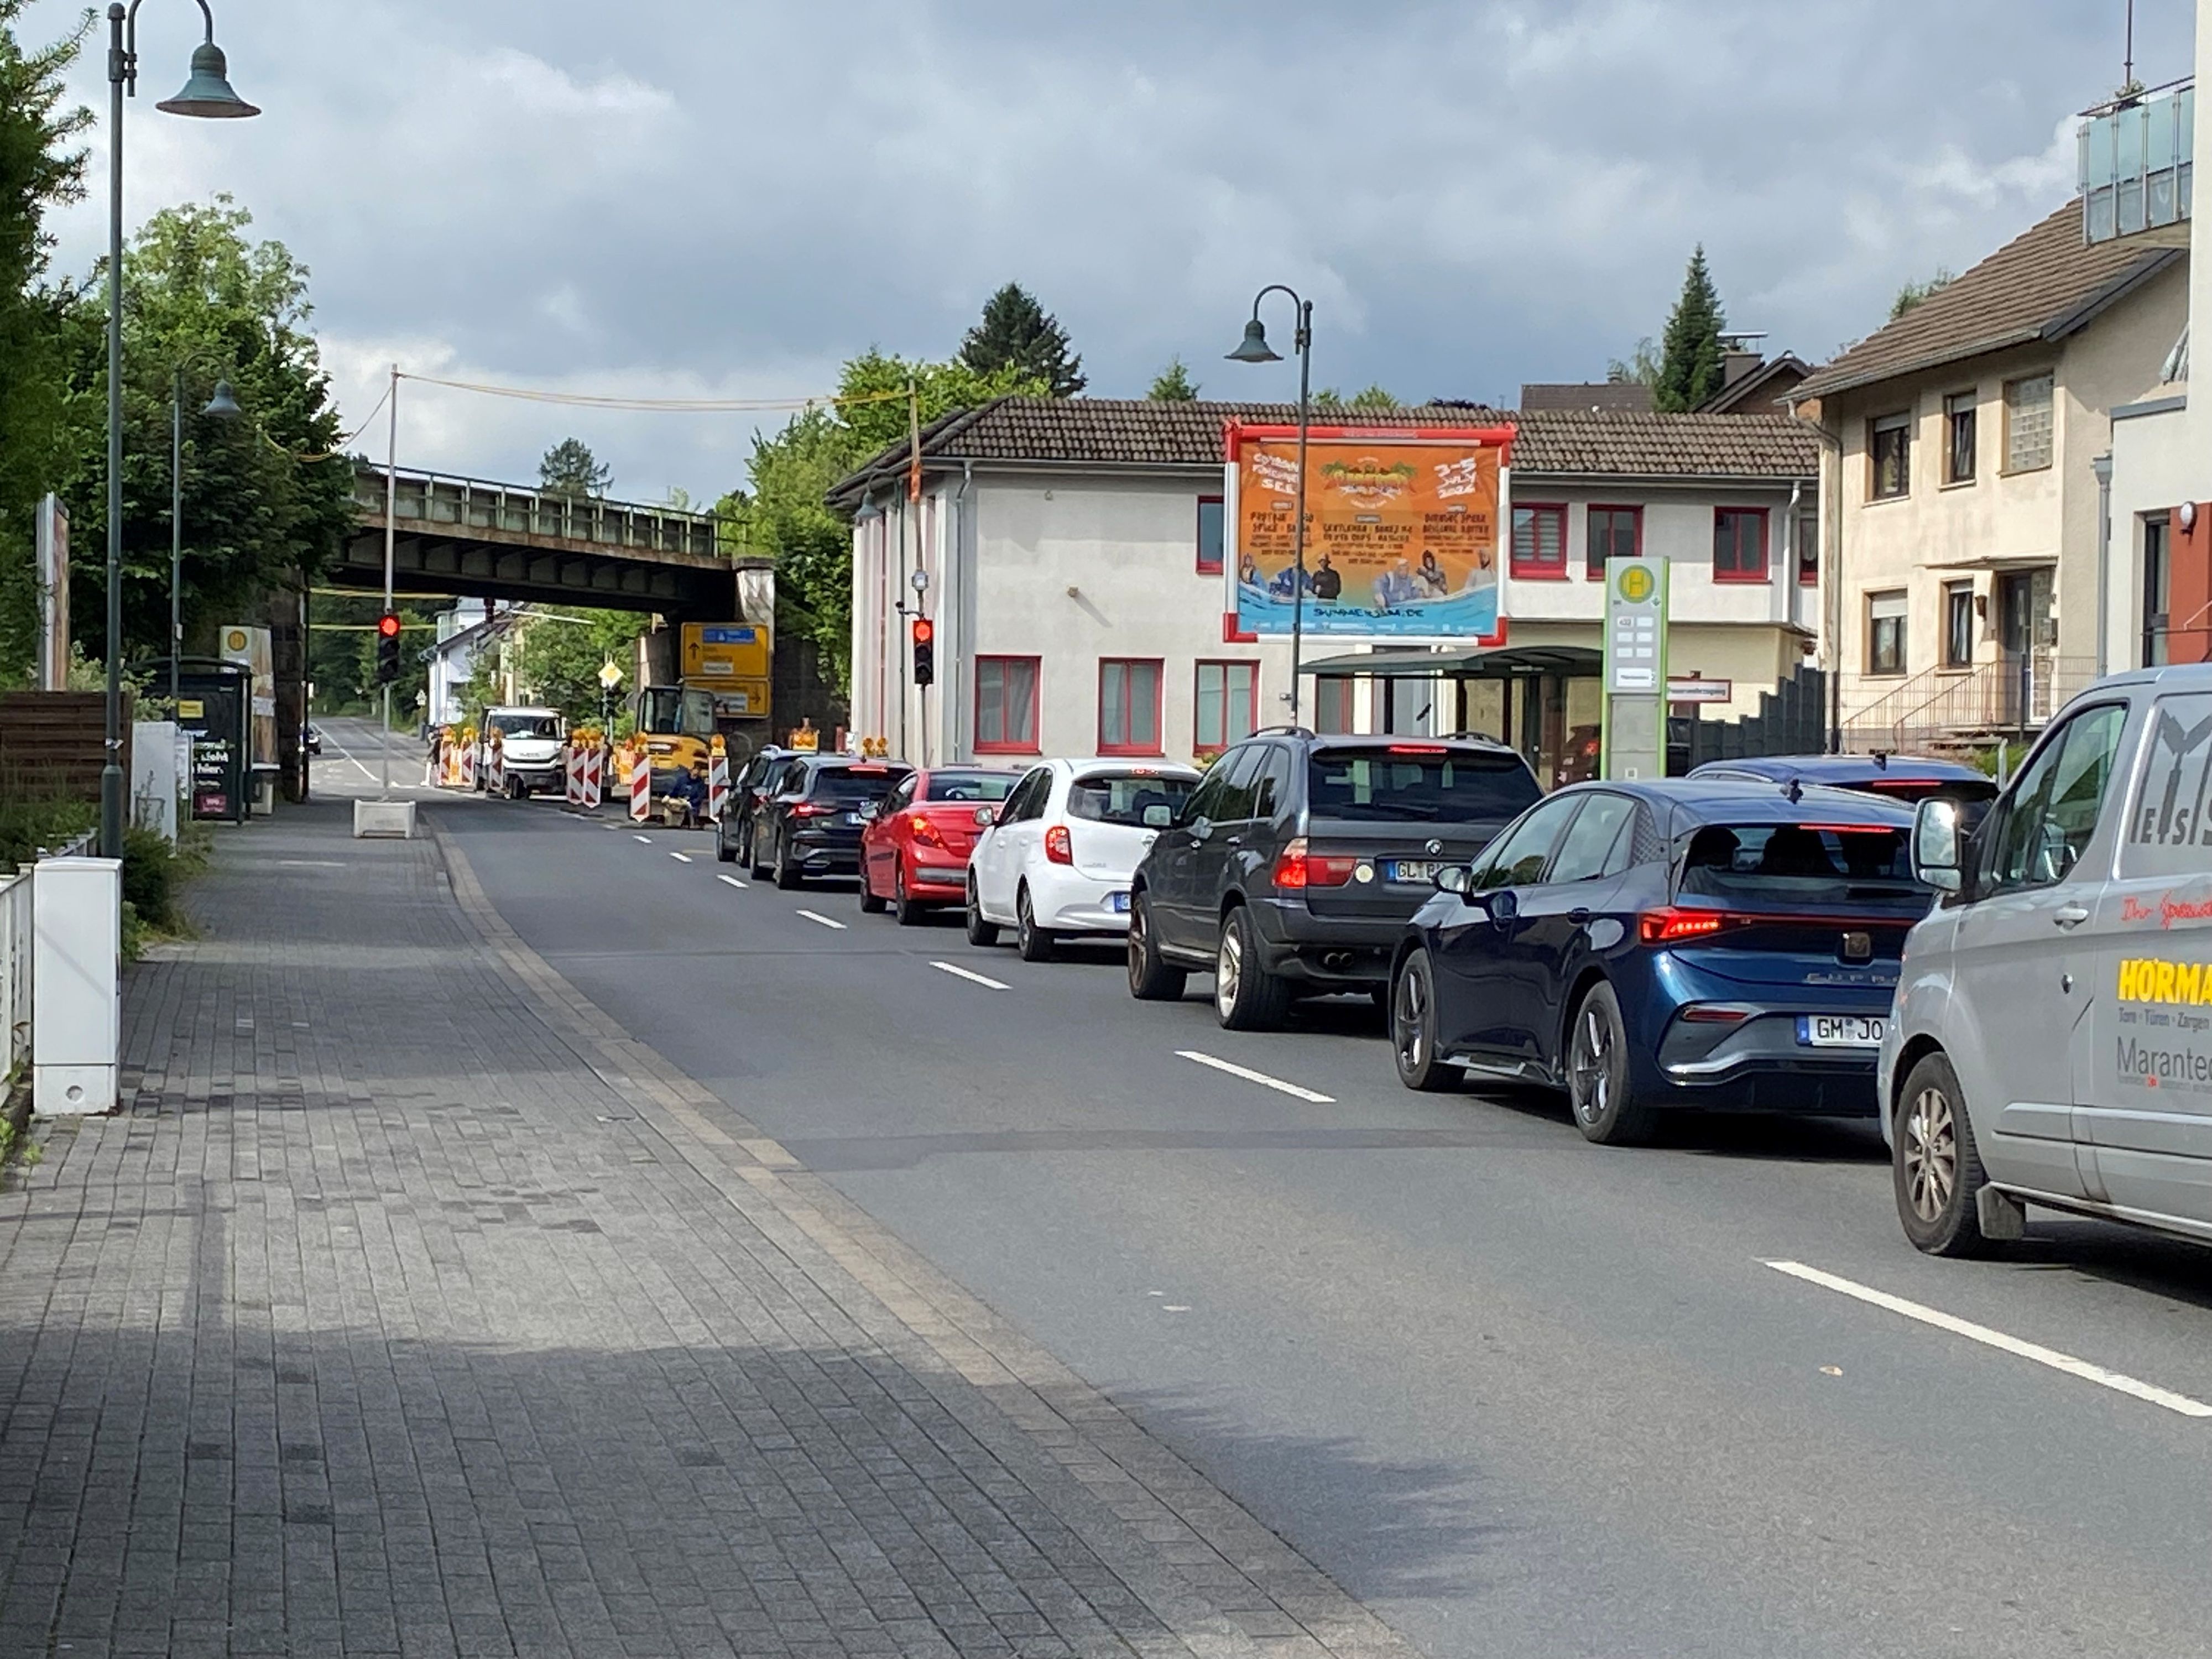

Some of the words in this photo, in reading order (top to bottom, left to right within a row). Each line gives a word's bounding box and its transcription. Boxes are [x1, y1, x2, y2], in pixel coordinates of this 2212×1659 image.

[1399, 863, 1416, 877] GL
[1817, 1019, 1843, 1039] GM
[2117, 1036, 2212, 1081] Marante
